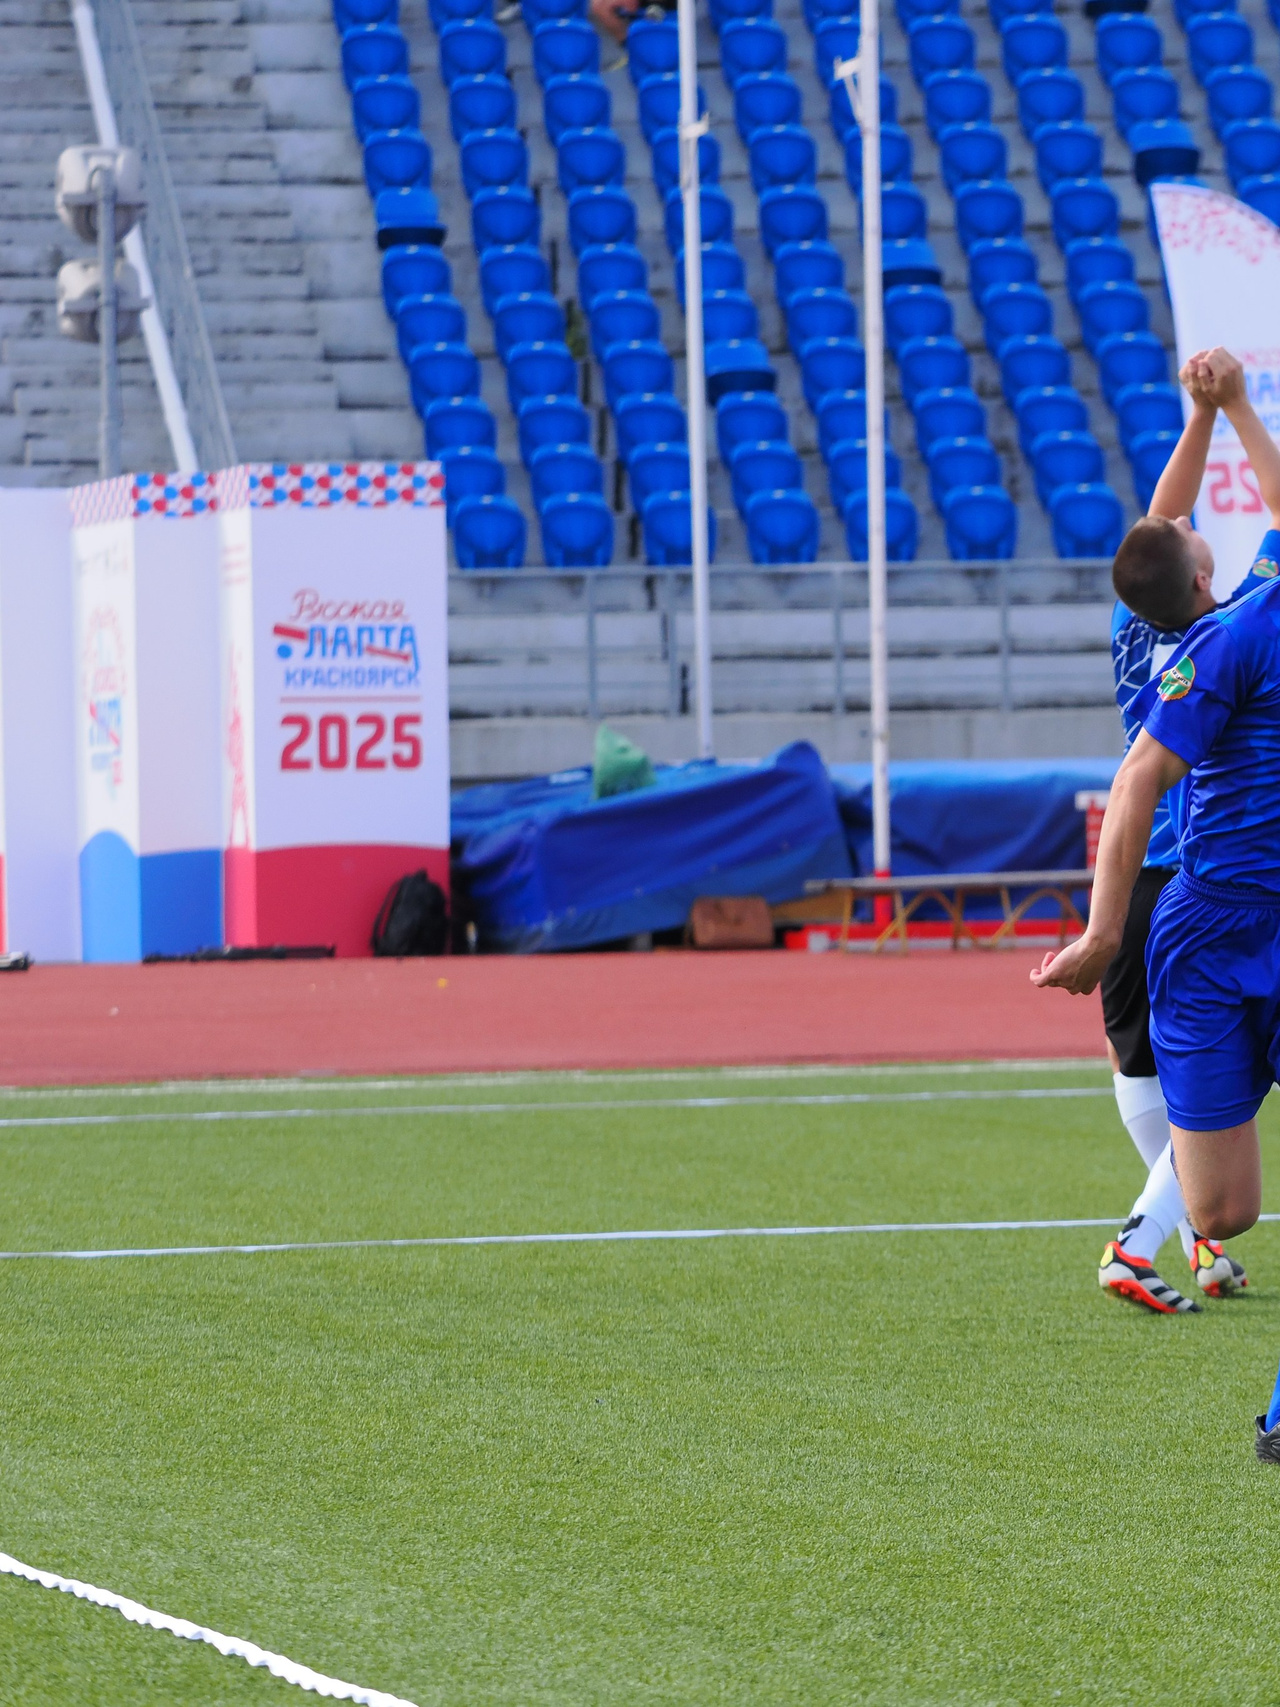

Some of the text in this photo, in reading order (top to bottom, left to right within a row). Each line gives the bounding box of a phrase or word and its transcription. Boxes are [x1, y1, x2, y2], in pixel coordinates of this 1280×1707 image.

[304, 624, 421, 676] ЛАПТА
[284, 665, 421, 690] КРАСНОЯРСК
[280, 712, 422, 771] 2025
